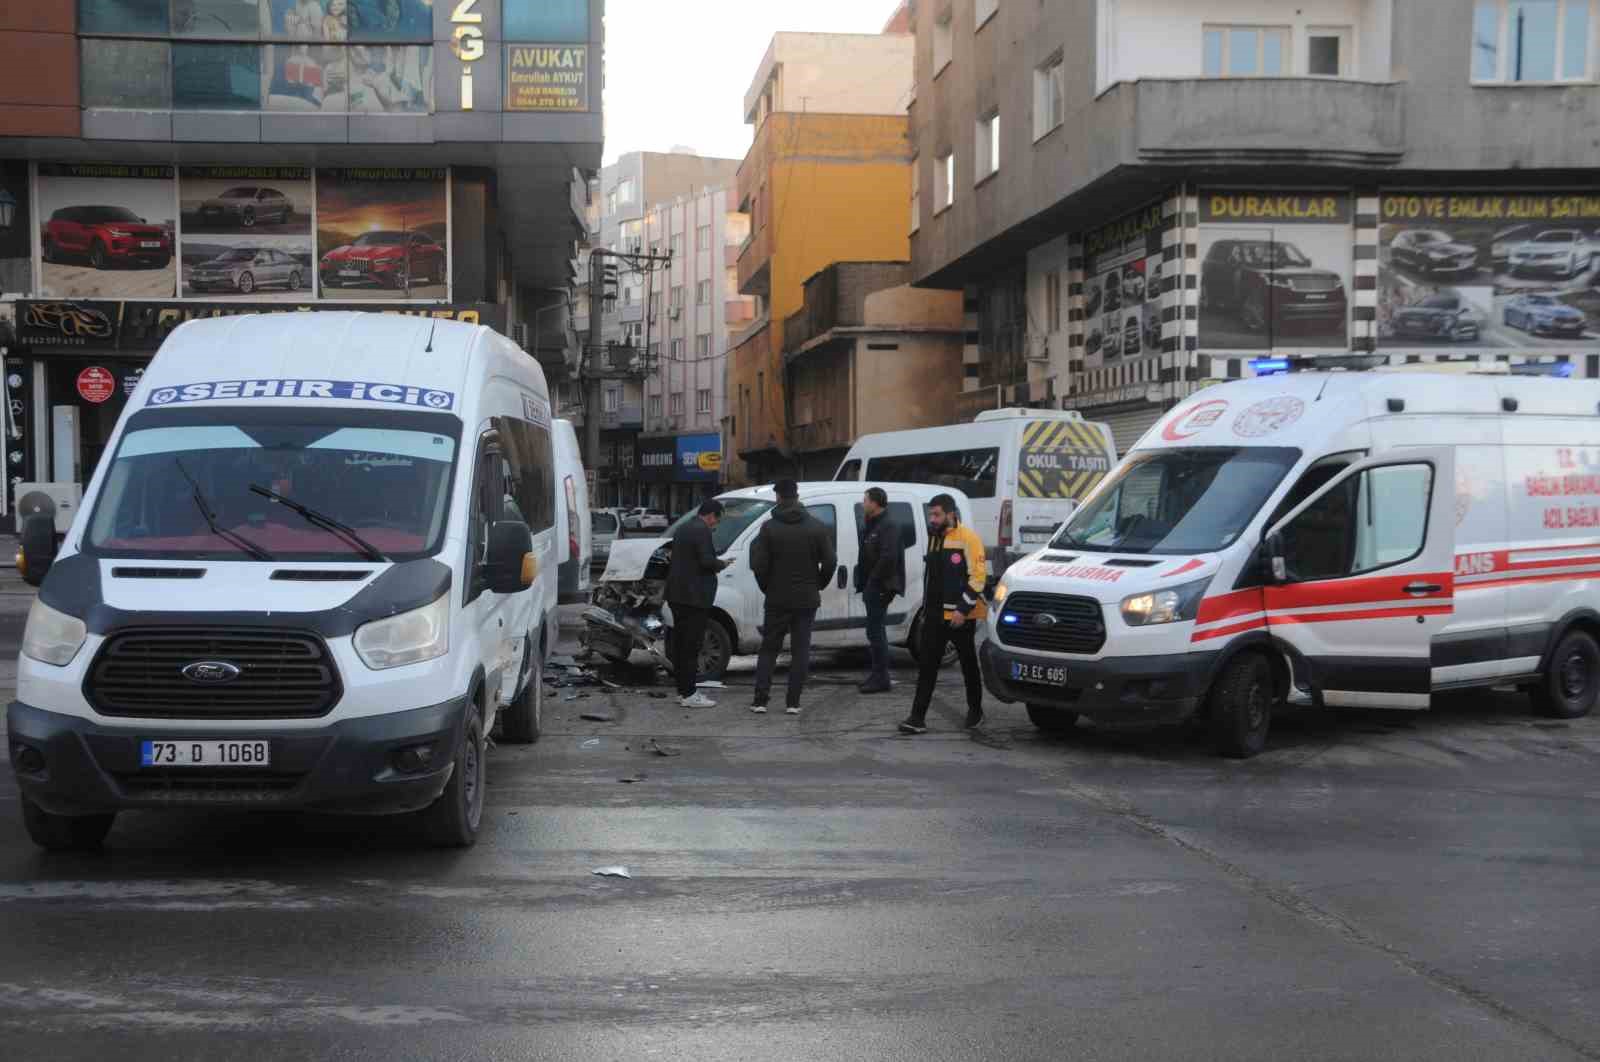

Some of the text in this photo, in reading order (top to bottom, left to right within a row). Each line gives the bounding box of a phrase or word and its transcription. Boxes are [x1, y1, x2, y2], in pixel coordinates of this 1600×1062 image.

[512, 49, 584, 68] AVUKAT
[553, 71, 584, 84] AYKUT
[1211, 197, 1337, 217] DURAKLAR
[1384, 197, 1420, 217] OTO
[1423, 198, 1445, 217] VE
[1449, 197, 1503, 217] EMLAK
[1507, 197, 1547, 217] ALIM
[642, 453, 672, 466] SAMSUNG
[1026, 454, 1060, 469] OKUL
[1018, 664, 1065, 682] 73 EC 605
[154, 743, 265, 762] 73 D 1068
